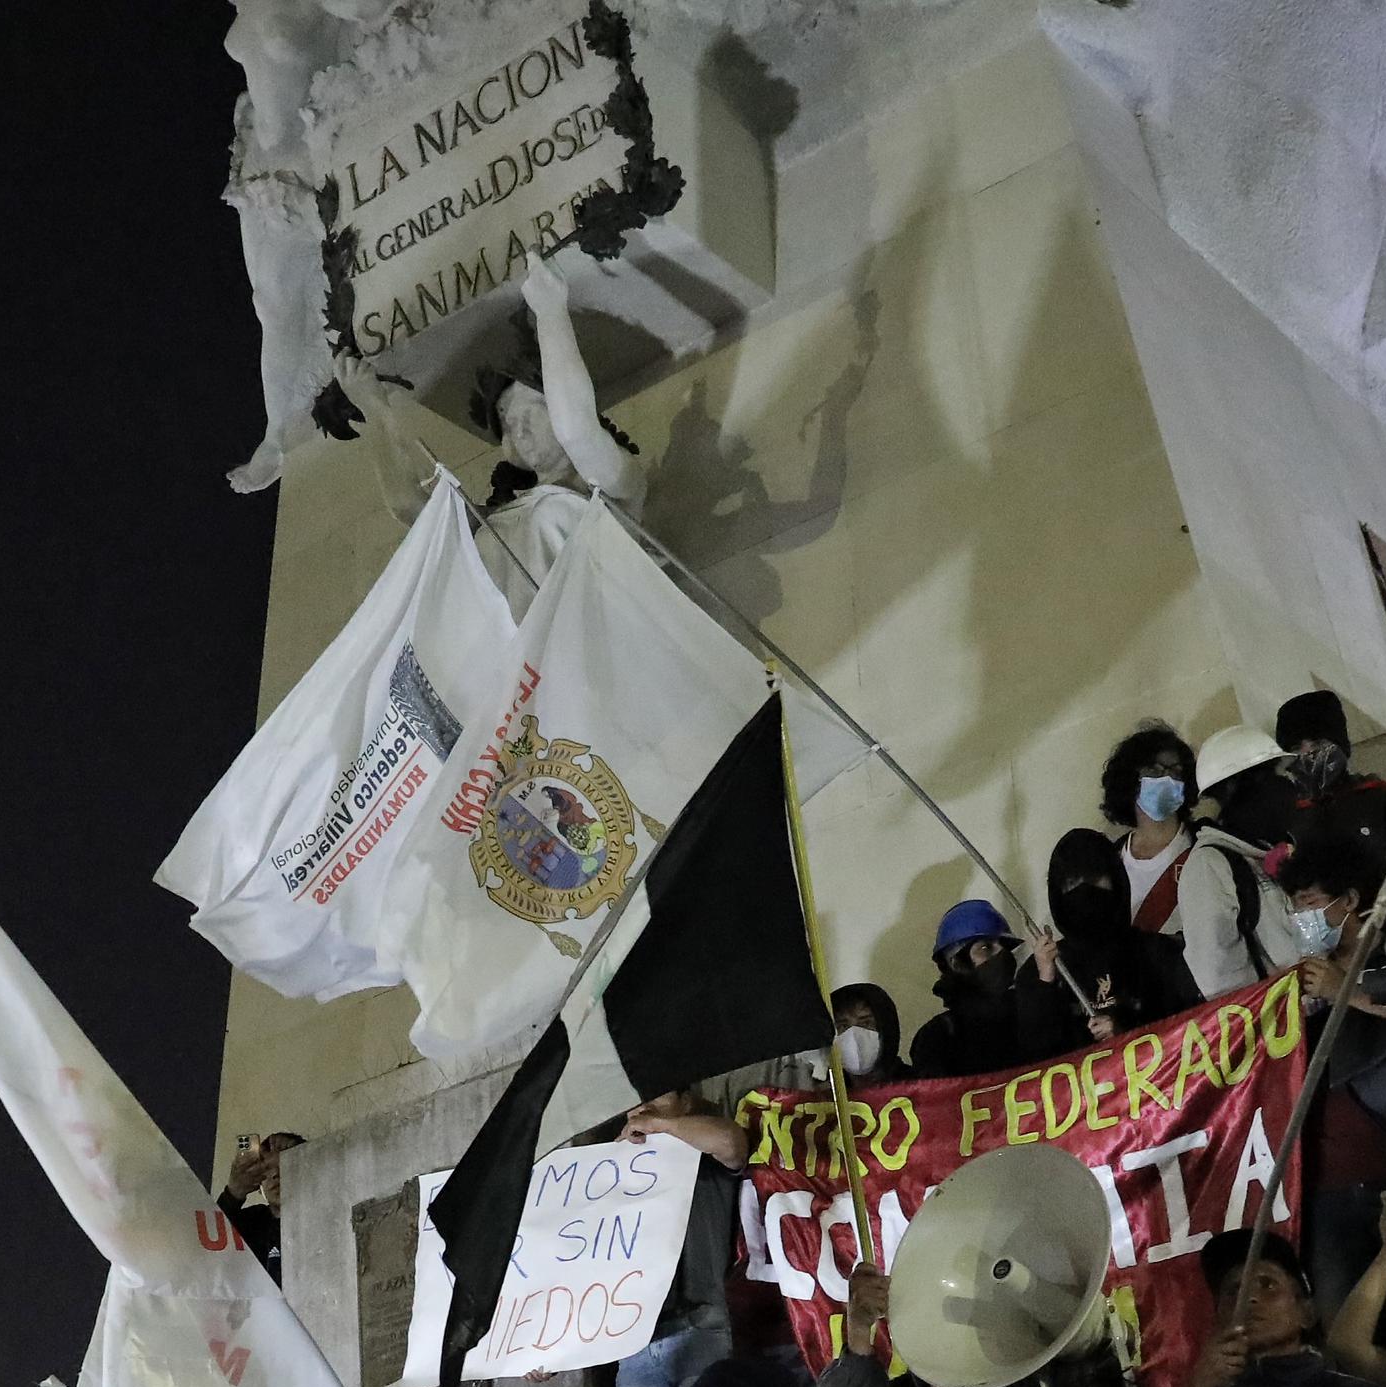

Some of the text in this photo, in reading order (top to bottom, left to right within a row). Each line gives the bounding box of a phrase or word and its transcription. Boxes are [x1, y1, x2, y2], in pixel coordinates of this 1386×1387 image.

[344, 19, 587, 210] LA NACION
[349, 247, 377, 280] AL
[959, 970, 1302, 1158] FEDERADO
[555, 1210, 643, 1262] SIN
[485, 1269, 645, 1363] IEDOS
